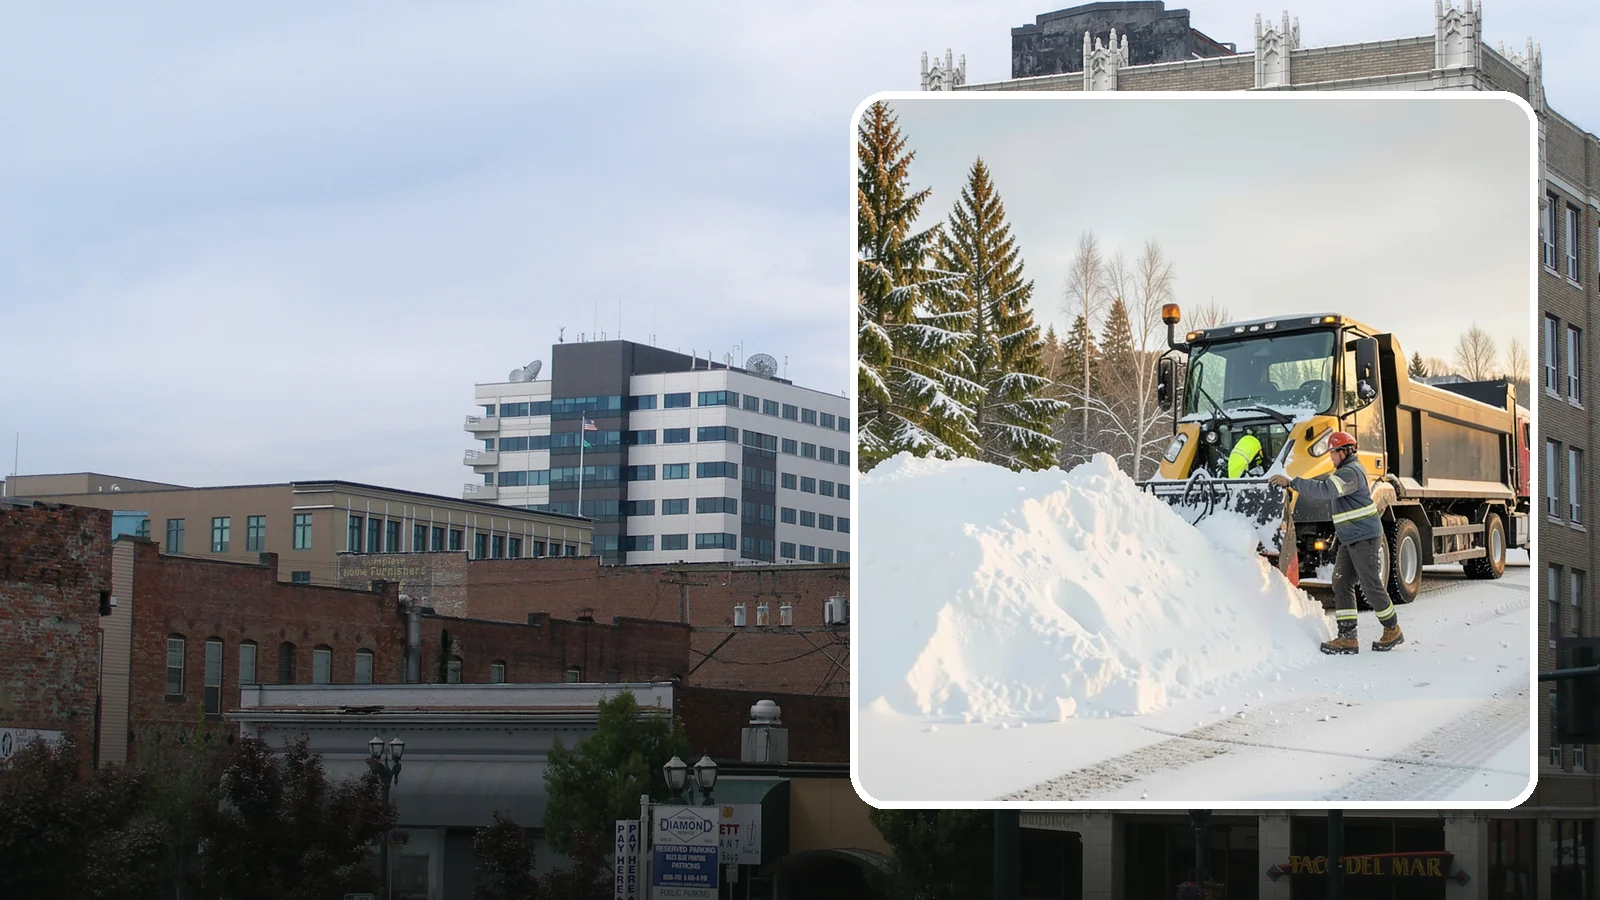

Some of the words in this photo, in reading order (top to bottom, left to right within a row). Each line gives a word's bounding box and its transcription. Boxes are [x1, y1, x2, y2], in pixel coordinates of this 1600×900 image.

[343, 568, 368, 577] Home
[370, 566, 427, 577] Furnishers
[660, 818, 713, 833] DIAMOND
[1022, 815, 1070, 828] BUILDING
[617, 825, 625, 852] PAY
[628, 824, 637, 852] PAY
[656, 845, 688, 853] RESERVED
[689, 846, 716, 854] PARKING
[671, 862, 701, 870] PATRONS
[1346, 856, 1385, 876] DEL
[1392, 857, 1442, 877] MAR
[616, 856, 625, 894] HERE
[627, 855, 636, 893] HERE
[660, 888, 682, 897] PUBLIC
[683, 889, 710, 898] PARKING
